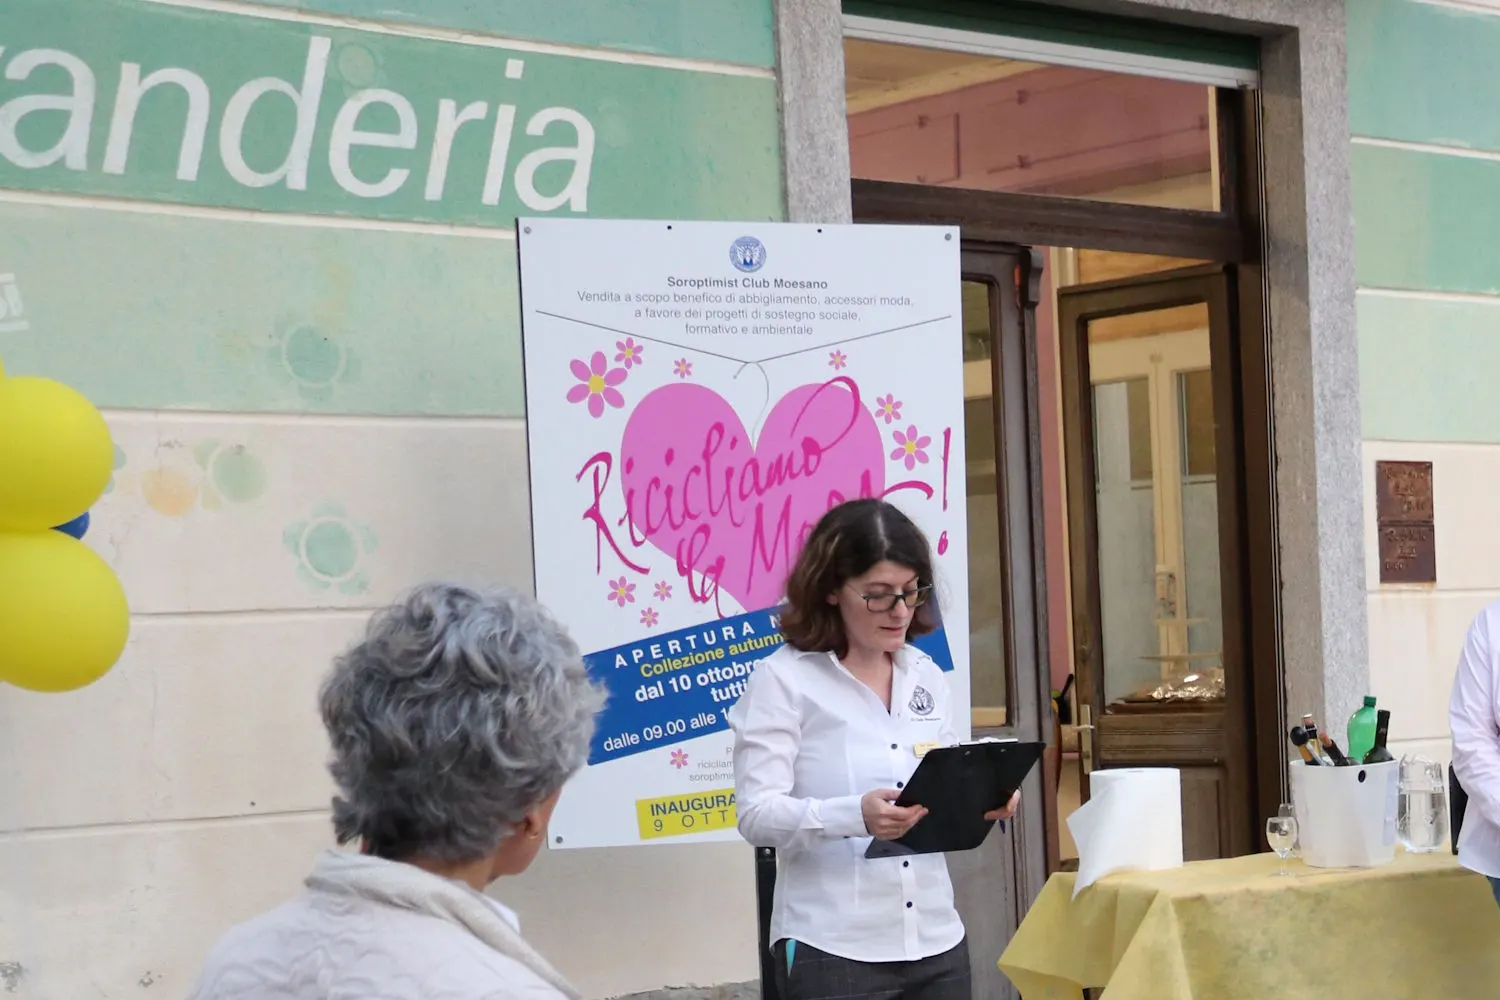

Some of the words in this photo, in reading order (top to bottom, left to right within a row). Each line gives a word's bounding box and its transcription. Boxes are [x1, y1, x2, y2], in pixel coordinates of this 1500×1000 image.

[0, 36, 596, 213] anderia
[667, 276, 738, 290] Soroptimist
[742, 277, 770, 289] Club
[774, 278, 828, 290] Moesano
[577, 290, 621, 302] Vendita
[624, 294, 632, 302] a
[635, 294, 670, 305] scopo
[674, 292, 721, 304] benefico
[725, 293, 736, 304] di
[739, 294, 821, 307] abbigliamento,
[824, 295, 877, 306] accessori
[880, 295, 915, 308] moda,
[634, 310, 642, 318] a
[645, 308, 681, 319] favore
[685, 308, 702, 319] dei
[705, 309, 748, 321] progetti
[751, 309, 761, 320] di
[764, 310, 816, 322] sostegno
[819, 311, 862, 322] sociale,
[685, 323, 738, 334] formativo
[741, 326, 748, 334] e
[752, 324, 814, 336] ambientale
[576, 375, 860, 575] Ricicliamo
[614, 621, 755, 669] APERTURA
[640, 647, 725, 678] Collezione
[728, 631, 785, 657] autunn
[635, 680, 665, 702] dal
[669, 674, 692, 694] 10
[603, 733, 641, 752] dalle
[643, 719, 686, 741] 09.00
[690, 712, 717, 730] alle
[650, 793, 737, 817] INAUGURA
[653, 819, 663, 832] 9
[681, 809, 738, 829] OTT
